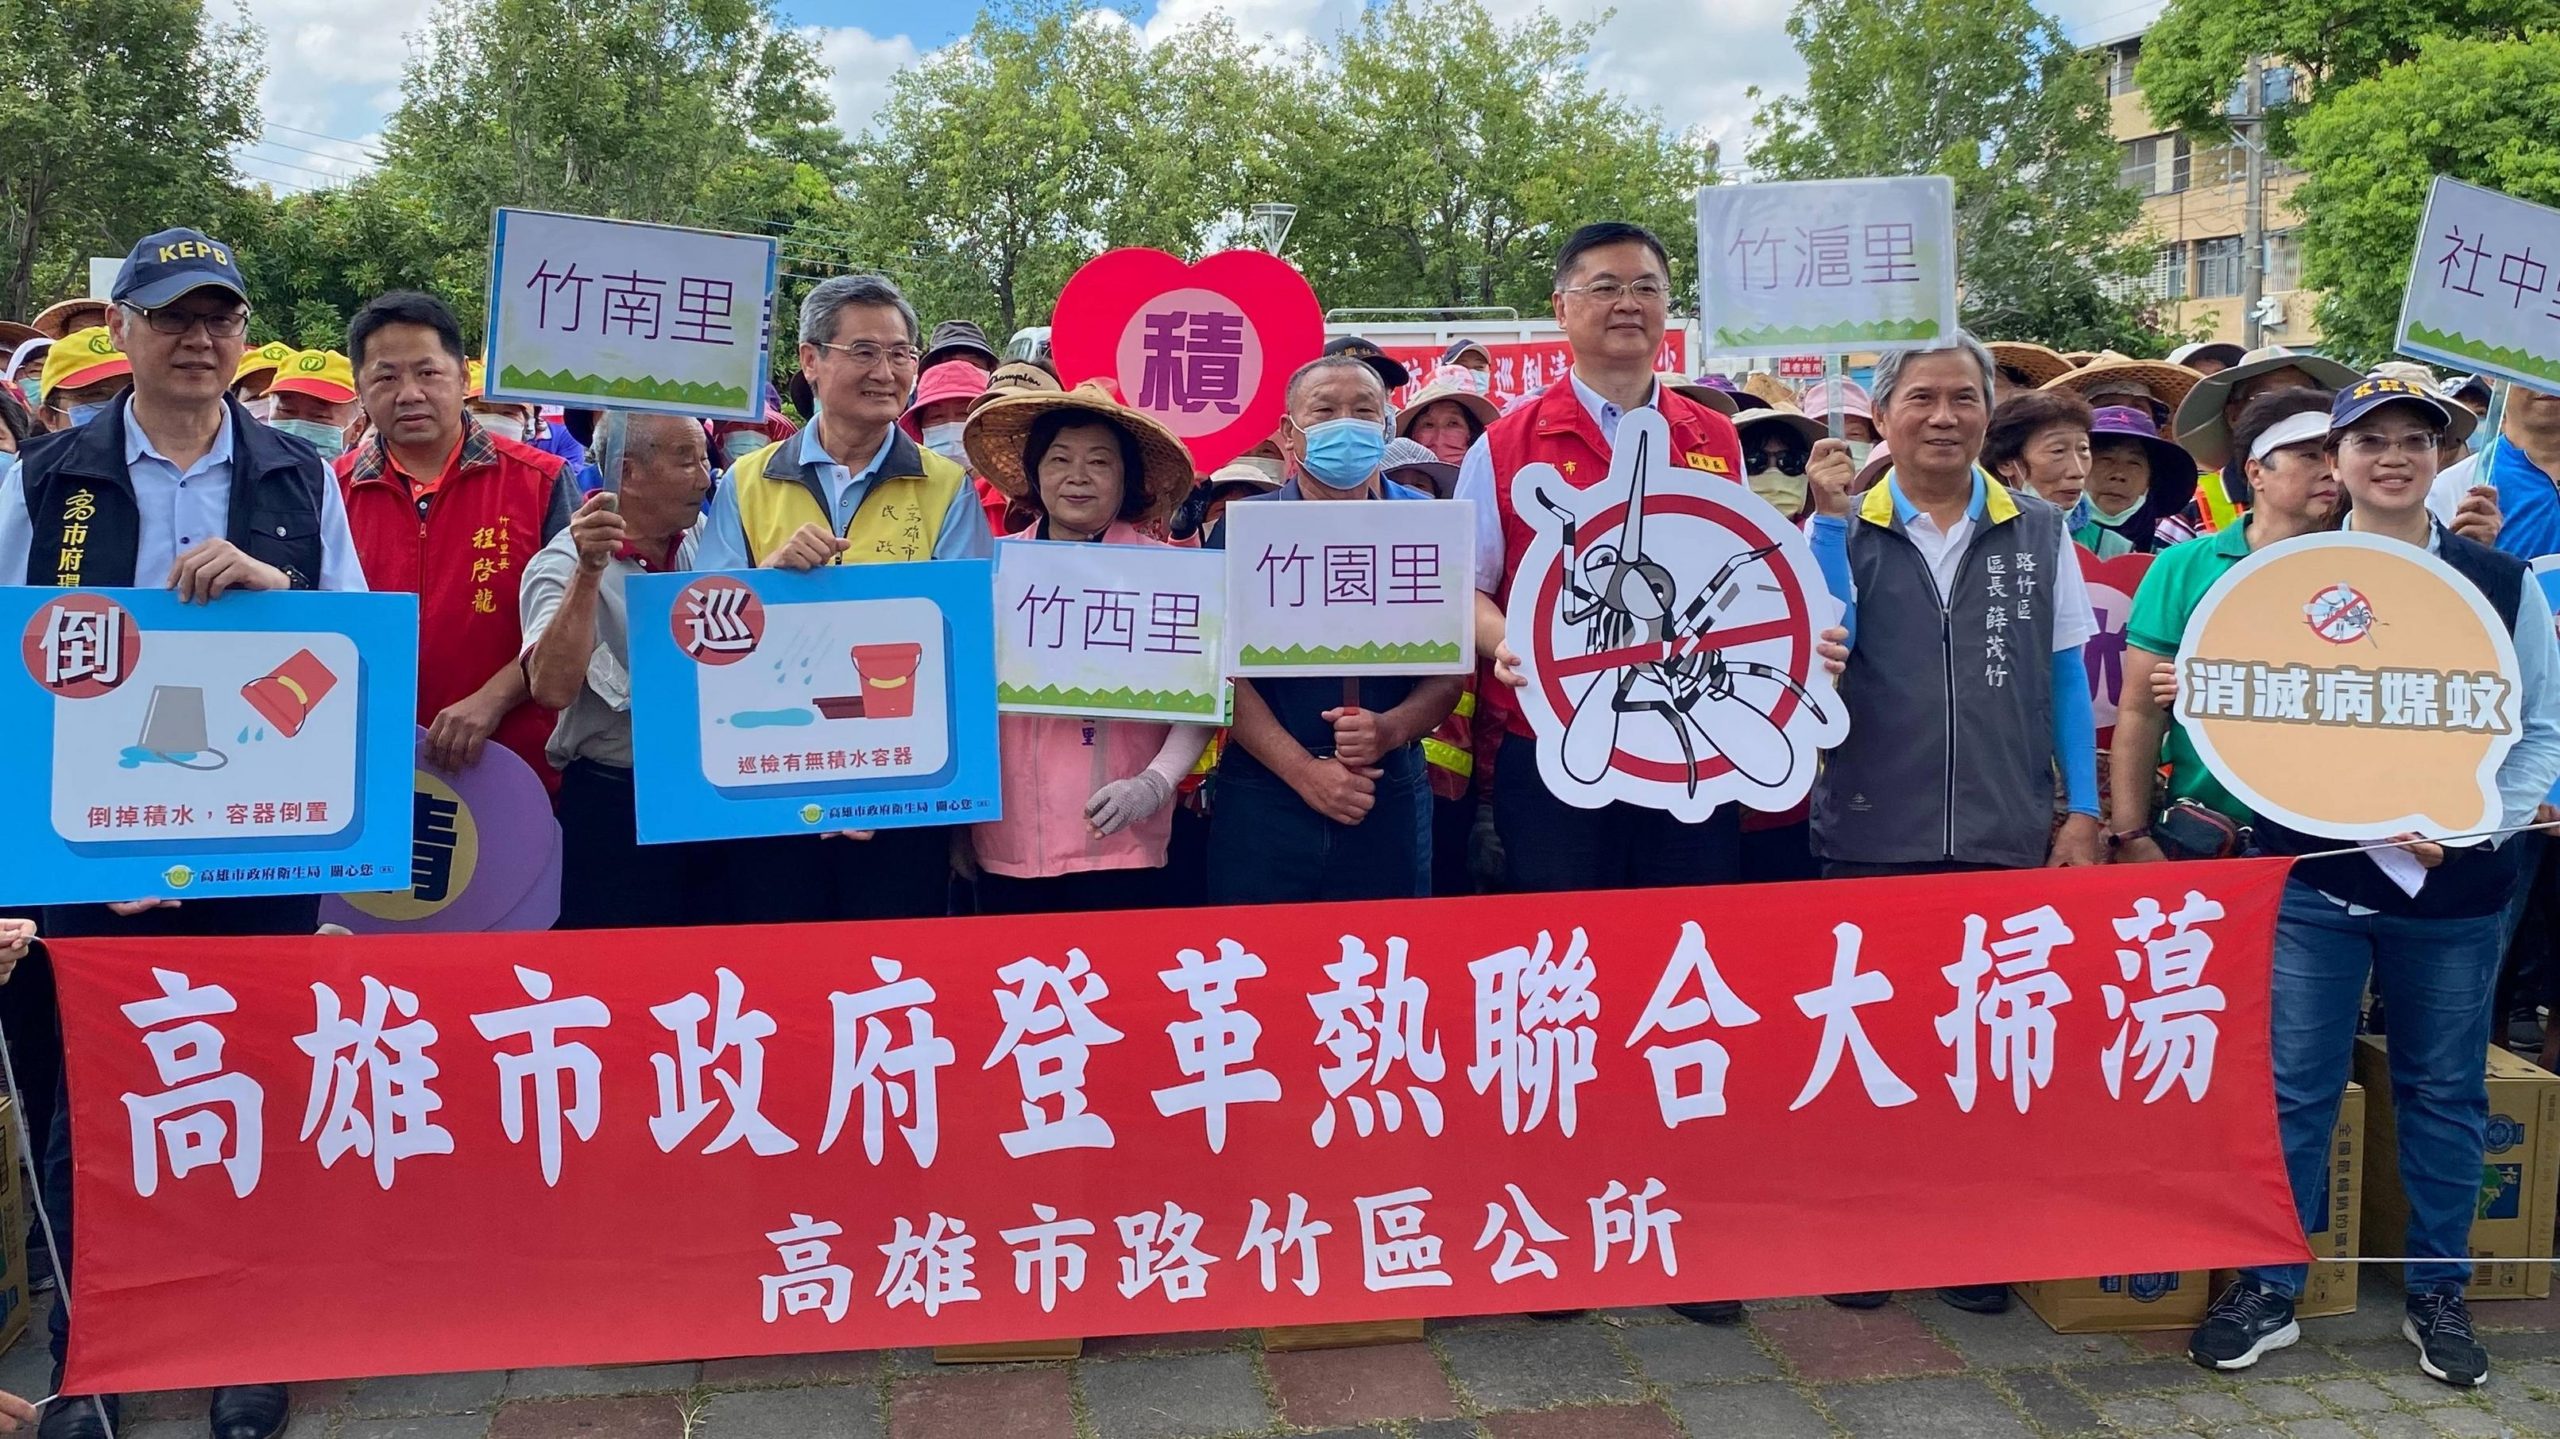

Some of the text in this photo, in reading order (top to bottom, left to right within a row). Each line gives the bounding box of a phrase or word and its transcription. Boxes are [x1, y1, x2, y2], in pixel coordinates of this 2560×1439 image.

[159, 241, 228, 266] KEPB
[1727, 222, 1920, 291] 竹滬里
[2438, 224, 2560, 321] 社中
[526, 258, 735, 346] 竹南里
[1138, 310, 1245, 415] 積
[1255, 543, 1444, 608] 竹園里
[2015, 552, 2038, 620] 路竹區
[39, 604, 121, 684] 倒
[684, 586, 754, 654] 巡
[1016, 583, 1203, 655] 竹西里
[2188, 661, 2508, 732] 消滅病媒蚊
[738, 746, 913, 775] 巡檢有無積水容器
[119, 889, 2228, 1199] 高雄市政府登革熱聯合大掃蕩
[761, 1177, 1682, 1324] 高雄市路竹區公所
